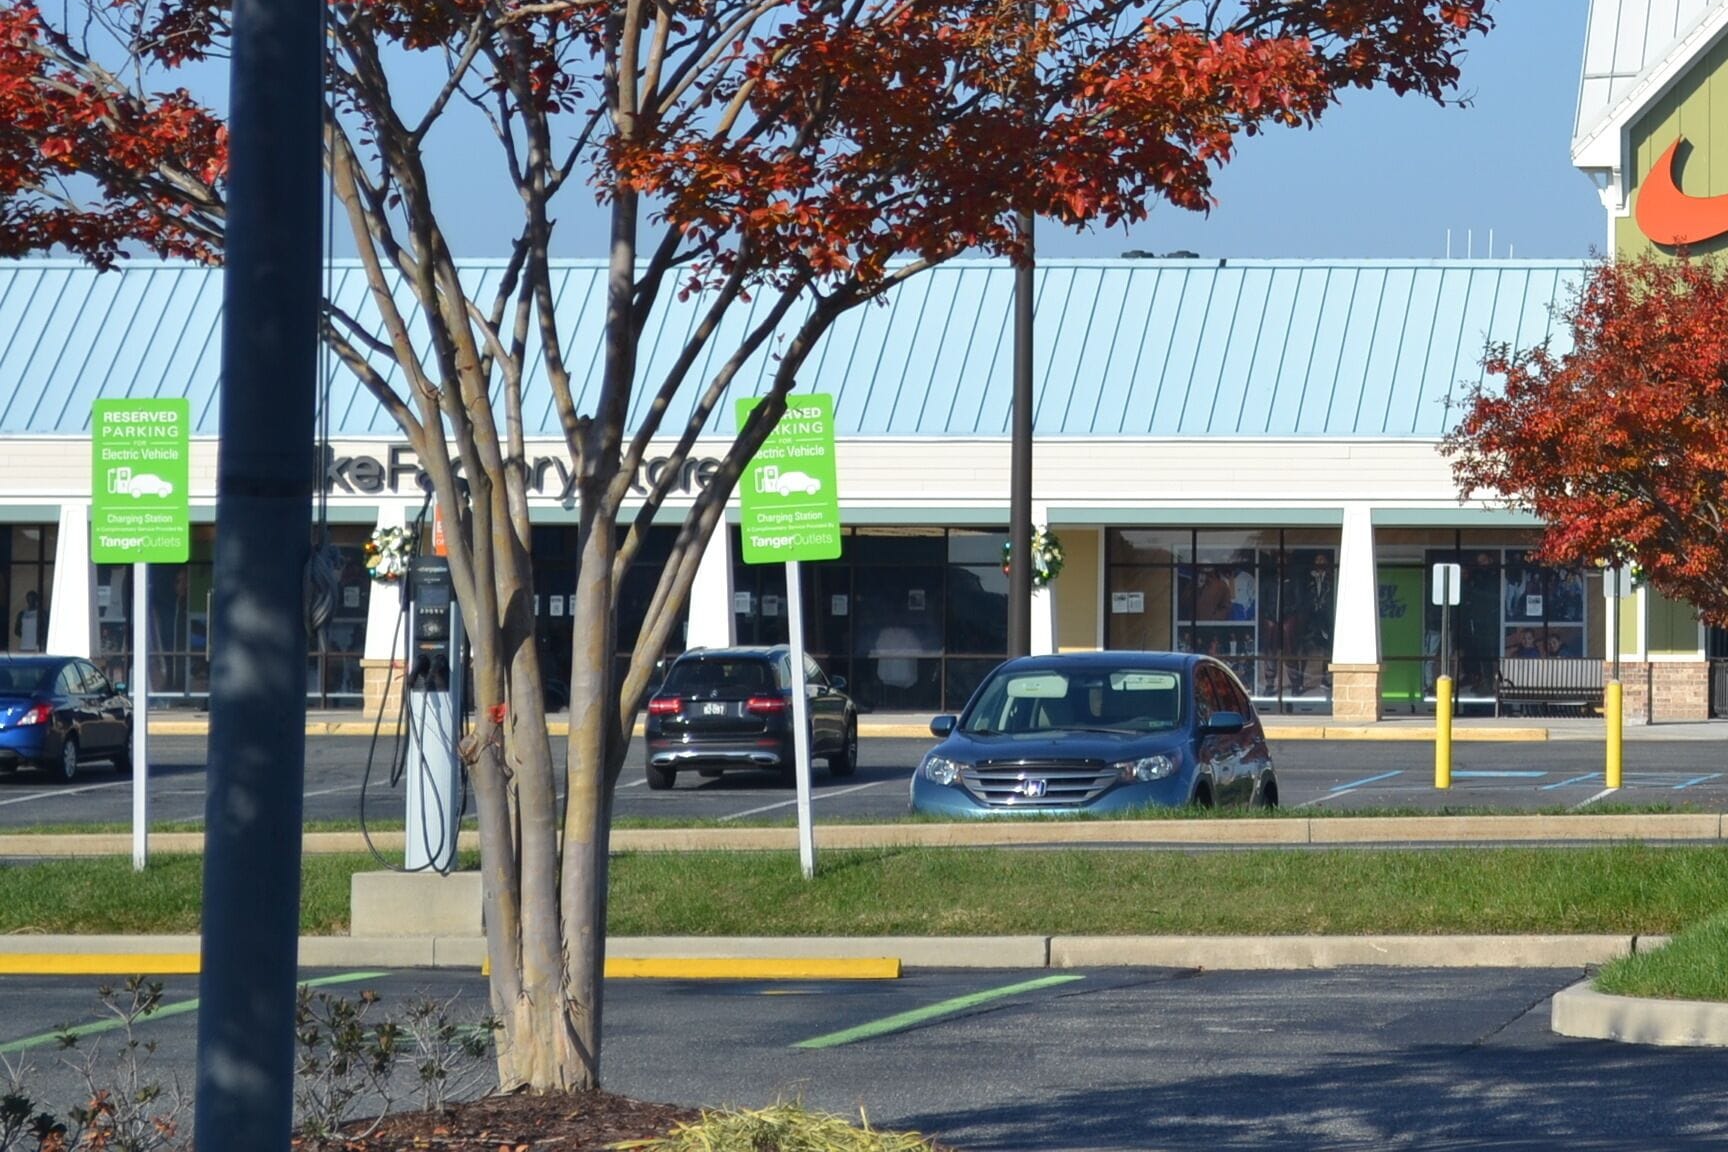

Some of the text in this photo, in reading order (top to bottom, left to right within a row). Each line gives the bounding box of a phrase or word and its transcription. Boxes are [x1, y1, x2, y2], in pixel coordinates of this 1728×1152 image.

[103, 411, 178, 423] RESERVED
[102, 425, 179, 438] PARKING
[102, 448, 178, 460] Electric Vehicle
[787, 444, 825, 457] Vehicle
[107, 513, 173, 525] Charging Station
[757, 510, 823, 524] Charging Station
